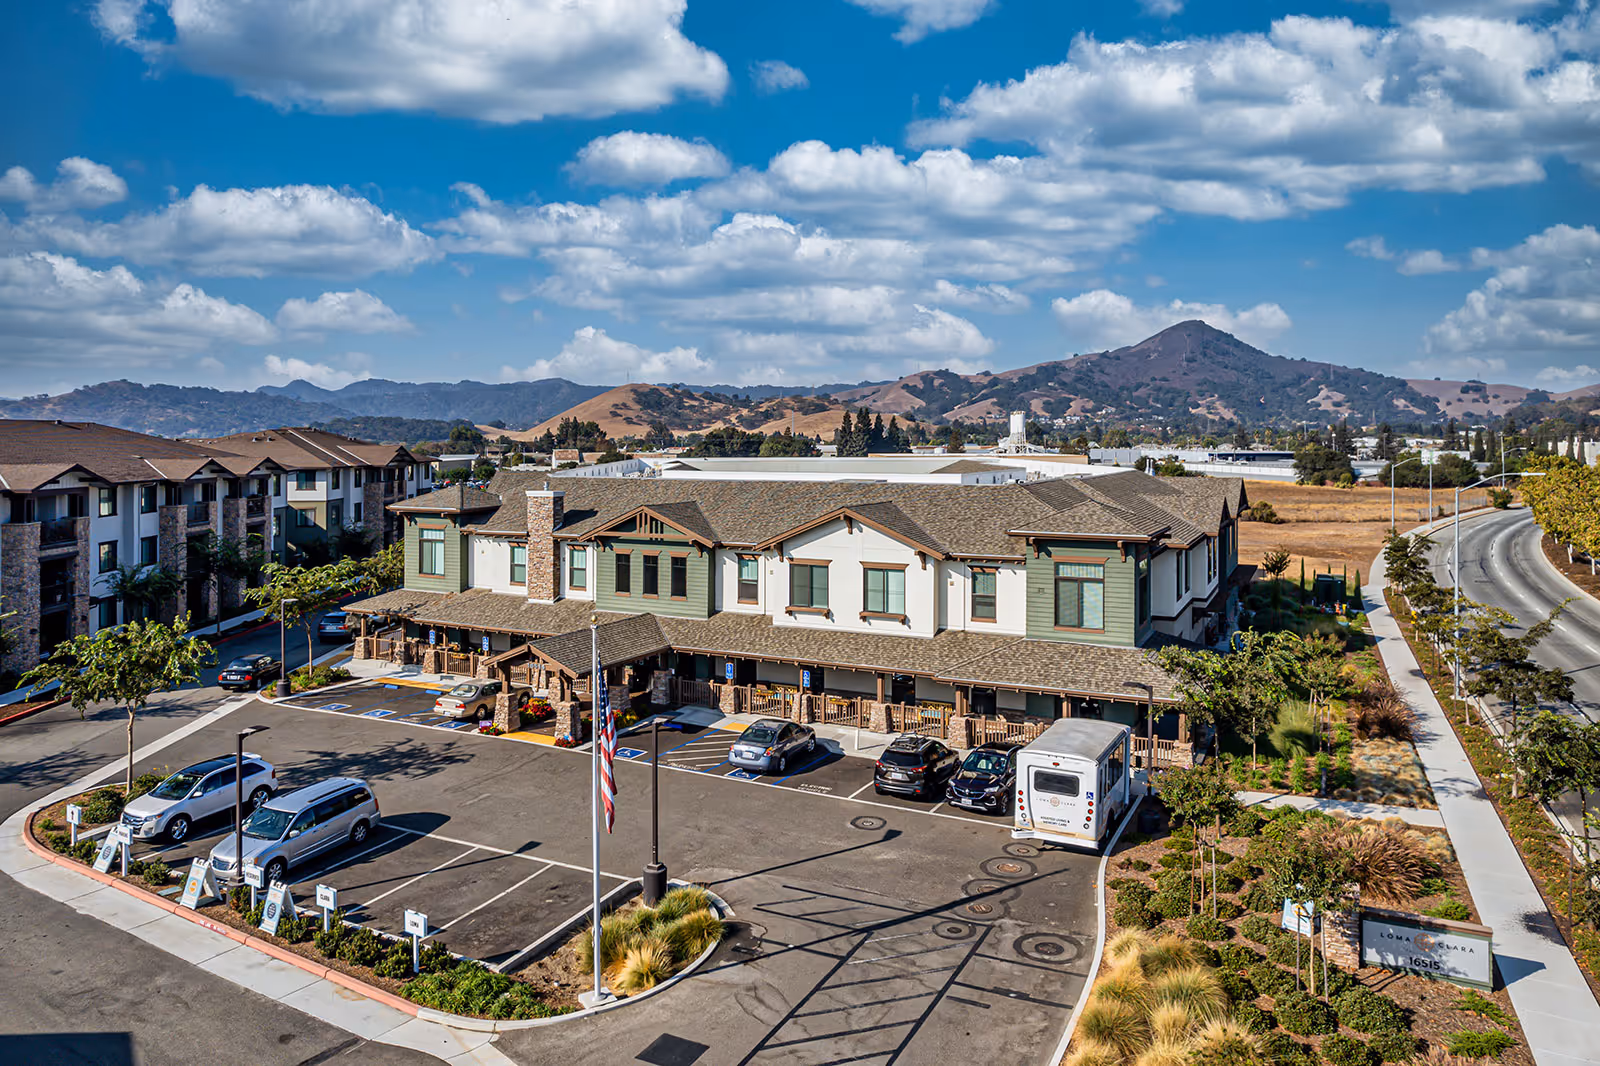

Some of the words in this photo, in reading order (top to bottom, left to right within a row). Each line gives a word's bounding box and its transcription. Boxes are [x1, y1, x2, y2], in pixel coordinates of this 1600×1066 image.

[1380, 932, 1411, 943] LOMA
[1437, 942, 1475, 954] CLARA
[1409, 956, 1441, 971] 16515
